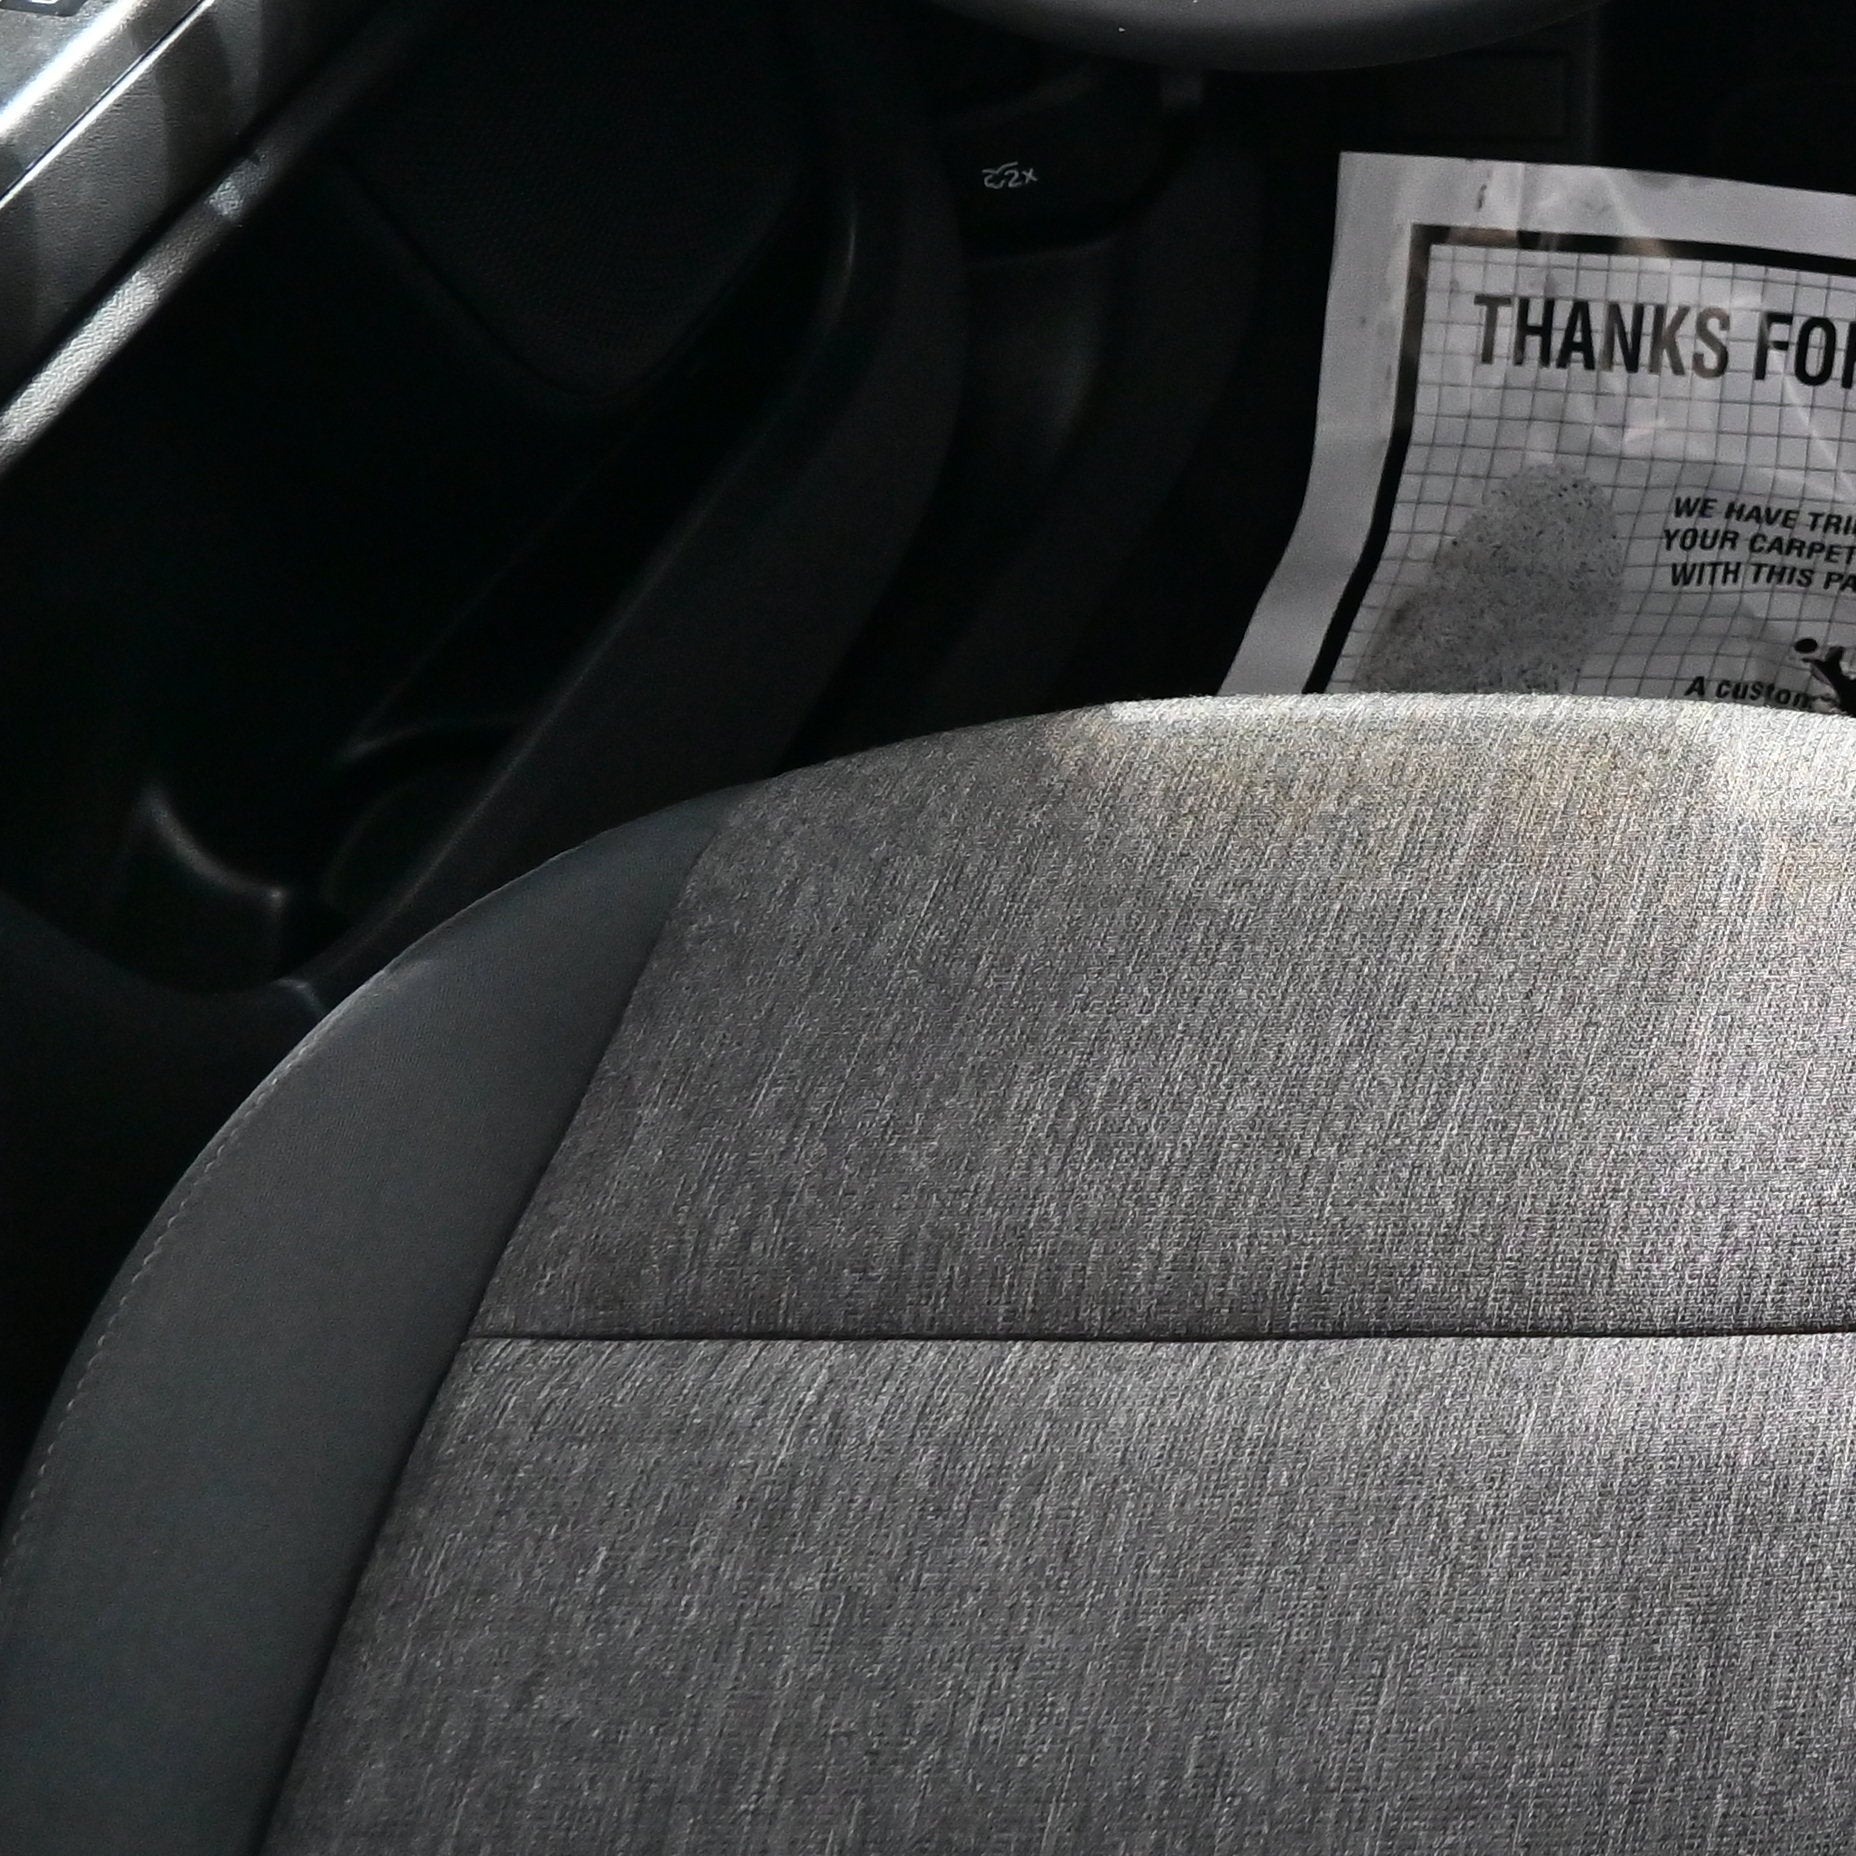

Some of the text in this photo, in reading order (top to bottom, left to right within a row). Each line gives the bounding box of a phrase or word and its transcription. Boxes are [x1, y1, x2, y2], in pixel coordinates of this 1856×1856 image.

[1473, 294, 1732, 380] THANKS
[1673, 496, 1717, 519] WE
[1724, 501, 1799, 531] HAVE
[1663, 527, 1740, 552] YOUR
[1669, 561, 1742, 587] WITH
[1751, 563, 1815, 589] THIS
[1683, 675, 1707, 698] A
